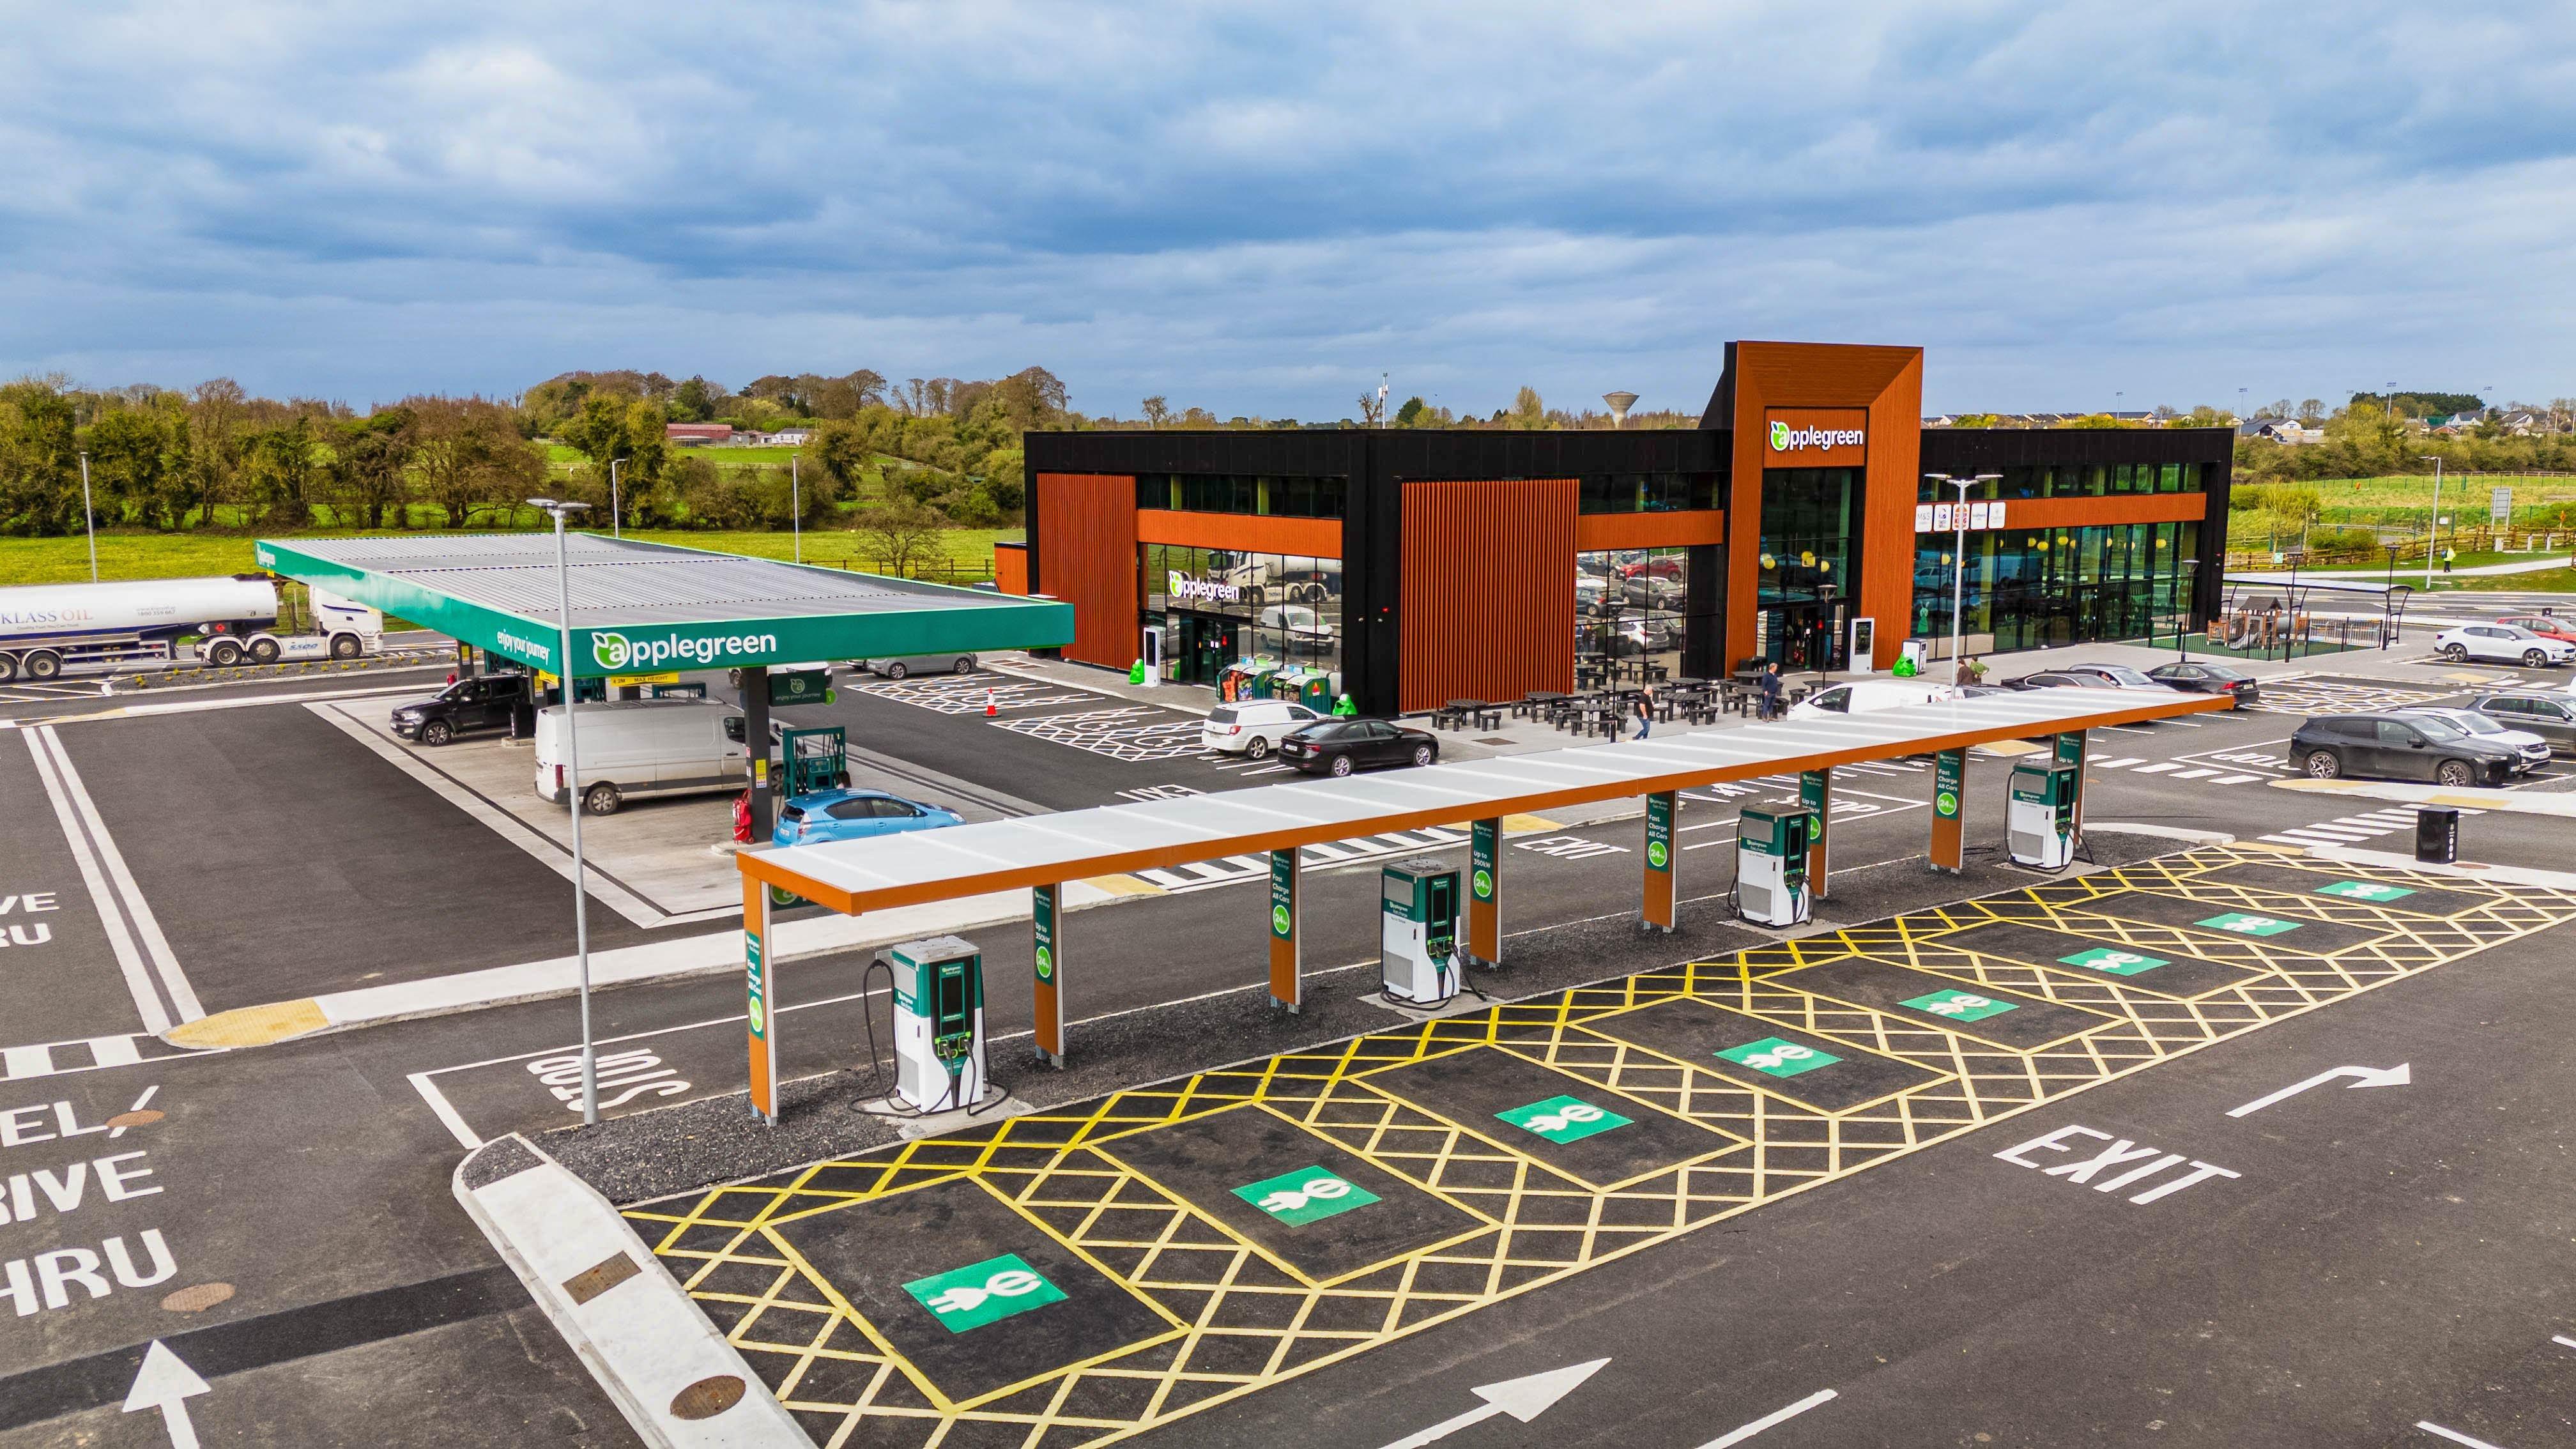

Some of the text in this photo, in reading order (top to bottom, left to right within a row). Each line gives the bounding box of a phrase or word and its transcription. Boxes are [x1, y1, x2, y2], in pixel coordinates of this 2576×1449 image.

[1770, 420, 1864, 451] applegreen
[1169, 570, 1239, 601] applegreen
[0, 610, 94, 624] KLASS OIL
[497, 628, 550, 666] enjoy your journey
[591, 632, 777, 670] applegreen
[2211, 753, 2302, 771] TOP
[1938, 776, 1958, 785] Charge
[1802, 797, 1809, 806] Up
[1648, 814, 1660, 822] Fast
[1648, 822, 1667, 832] Charge
[1656, 832, 1668, 840] Cars
[1512, 836, 1631, 859] EXIT
[1473, 858, 1491, 869] 350kW
[1272, 873, 1283, 883] Fast
[1272, 882, 1289, 895] Charge
[1278, 894, 1290, 904] Cars
[1035, 921, 1041, 932] Up
[1035, 931, 1050, 944] 350kW
[526, 1048, 691, 1112] STOP
[1992, 1124, 2242, 1206] EXIT
